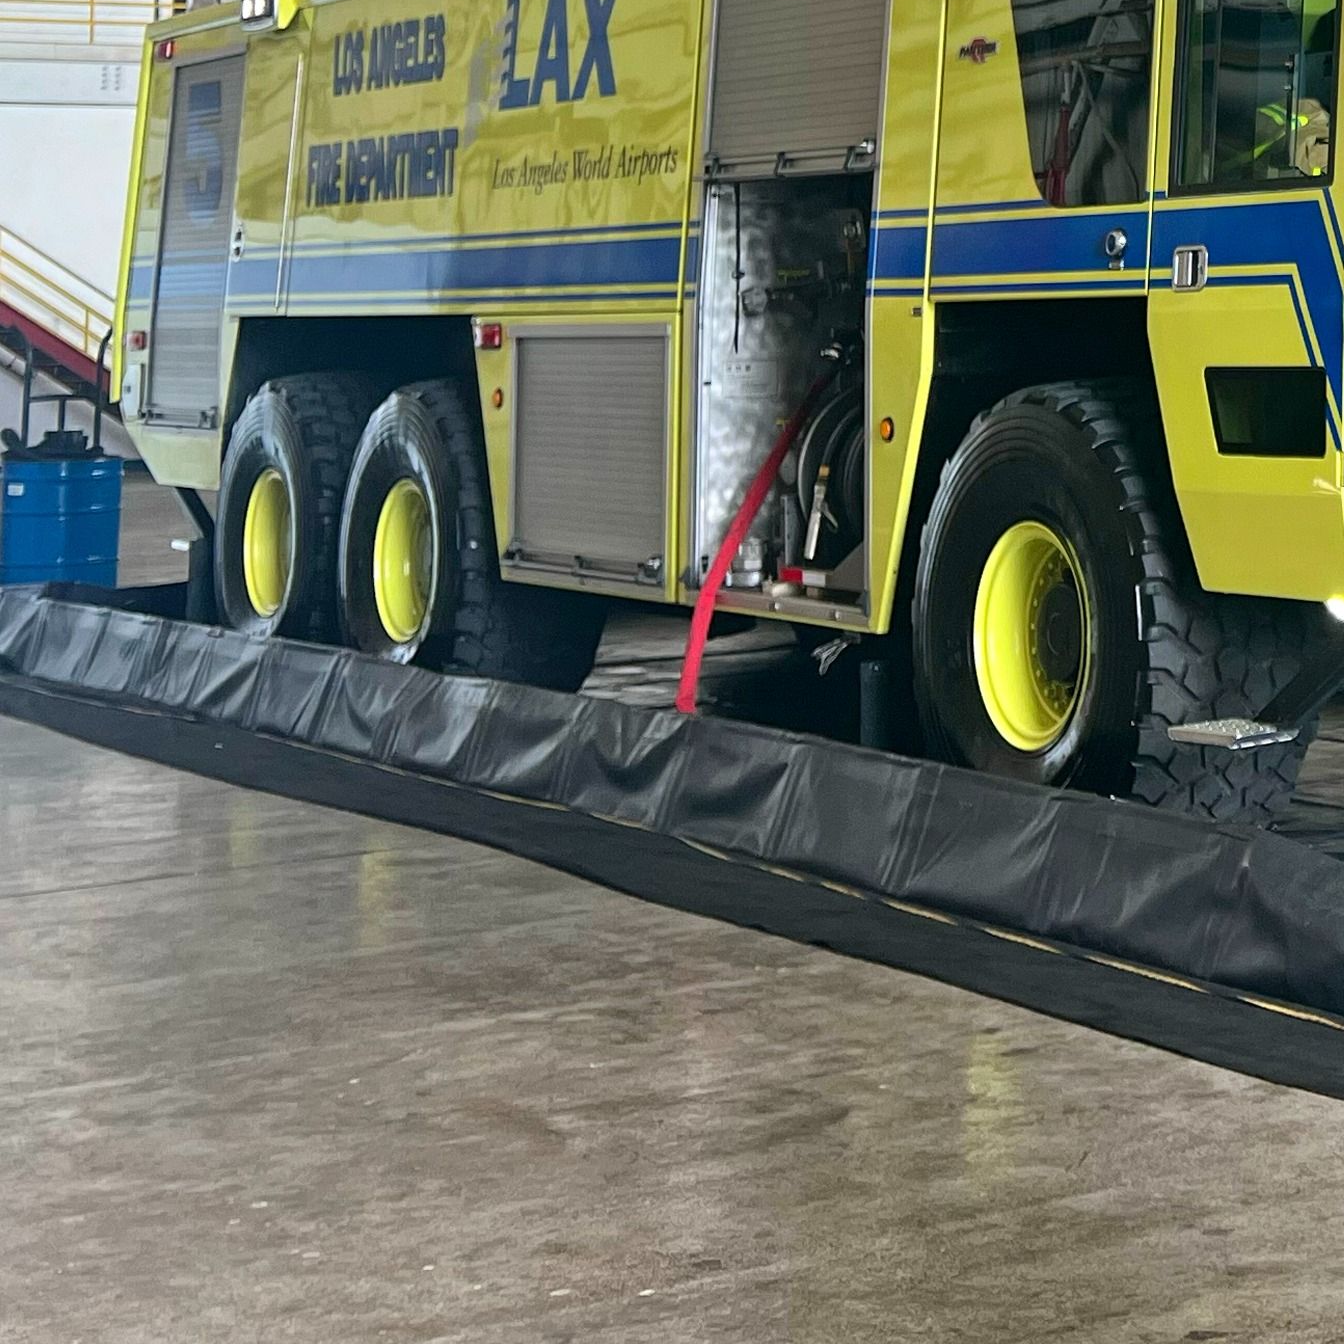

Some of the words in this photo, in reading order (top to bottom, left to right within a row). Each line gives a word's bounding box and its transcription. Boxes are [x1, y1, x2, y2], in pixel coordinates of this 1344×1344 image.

[333, 30, 365, 96] LOS
[367, 13, 446, 92] ANGELES
[306, 140, 343, 208] FIRE
[344, 128, 459, 204] DEPARTMENT
[492, 158, 516, 190] Los
[517, 150, 569, 195] Angeles
[572, 144, 614, 183] World
[615, 144, 678, 186] Airports
